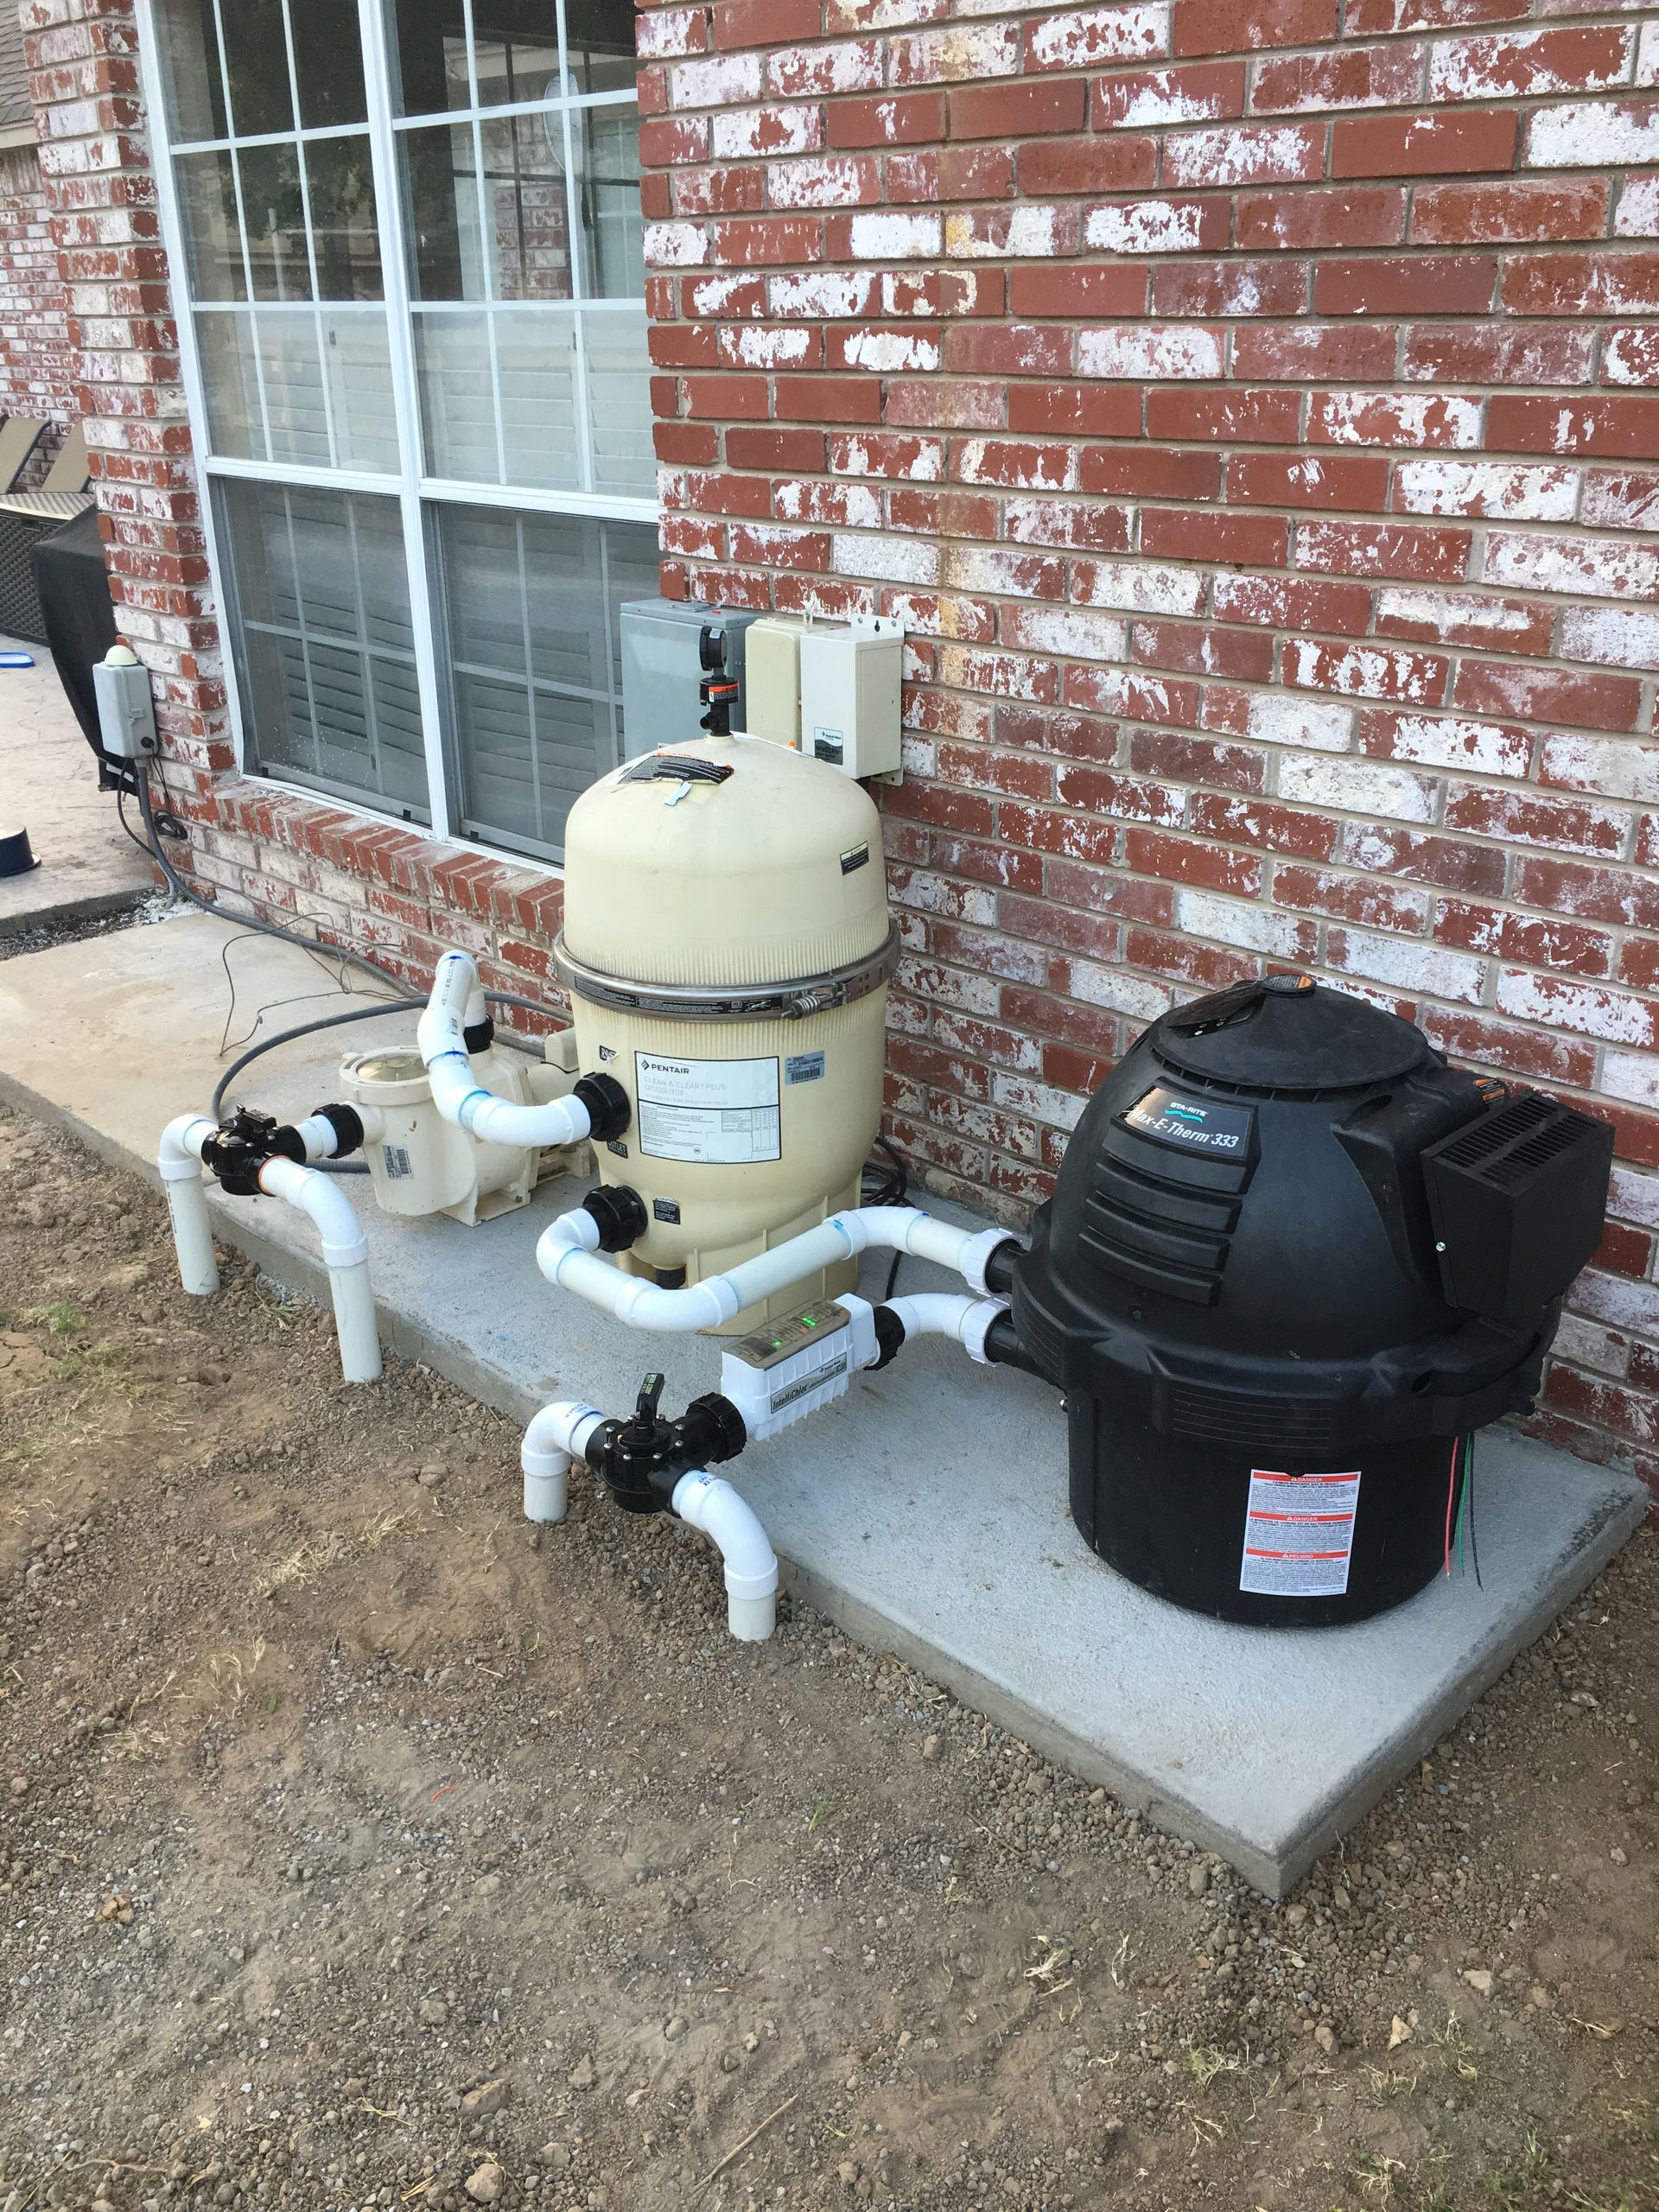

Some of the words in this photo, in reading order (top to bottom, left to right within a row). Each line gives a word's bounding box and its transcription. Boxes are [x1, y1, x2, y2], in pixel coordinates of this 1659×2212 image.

[652, 1063, 690, 1074] PENTAIR
[644, 1076, 667, 1086] CLEAN
[1211, 1133, 1239, 1148] 333
[772, 1383, 808, 1410] IntelliChlor
